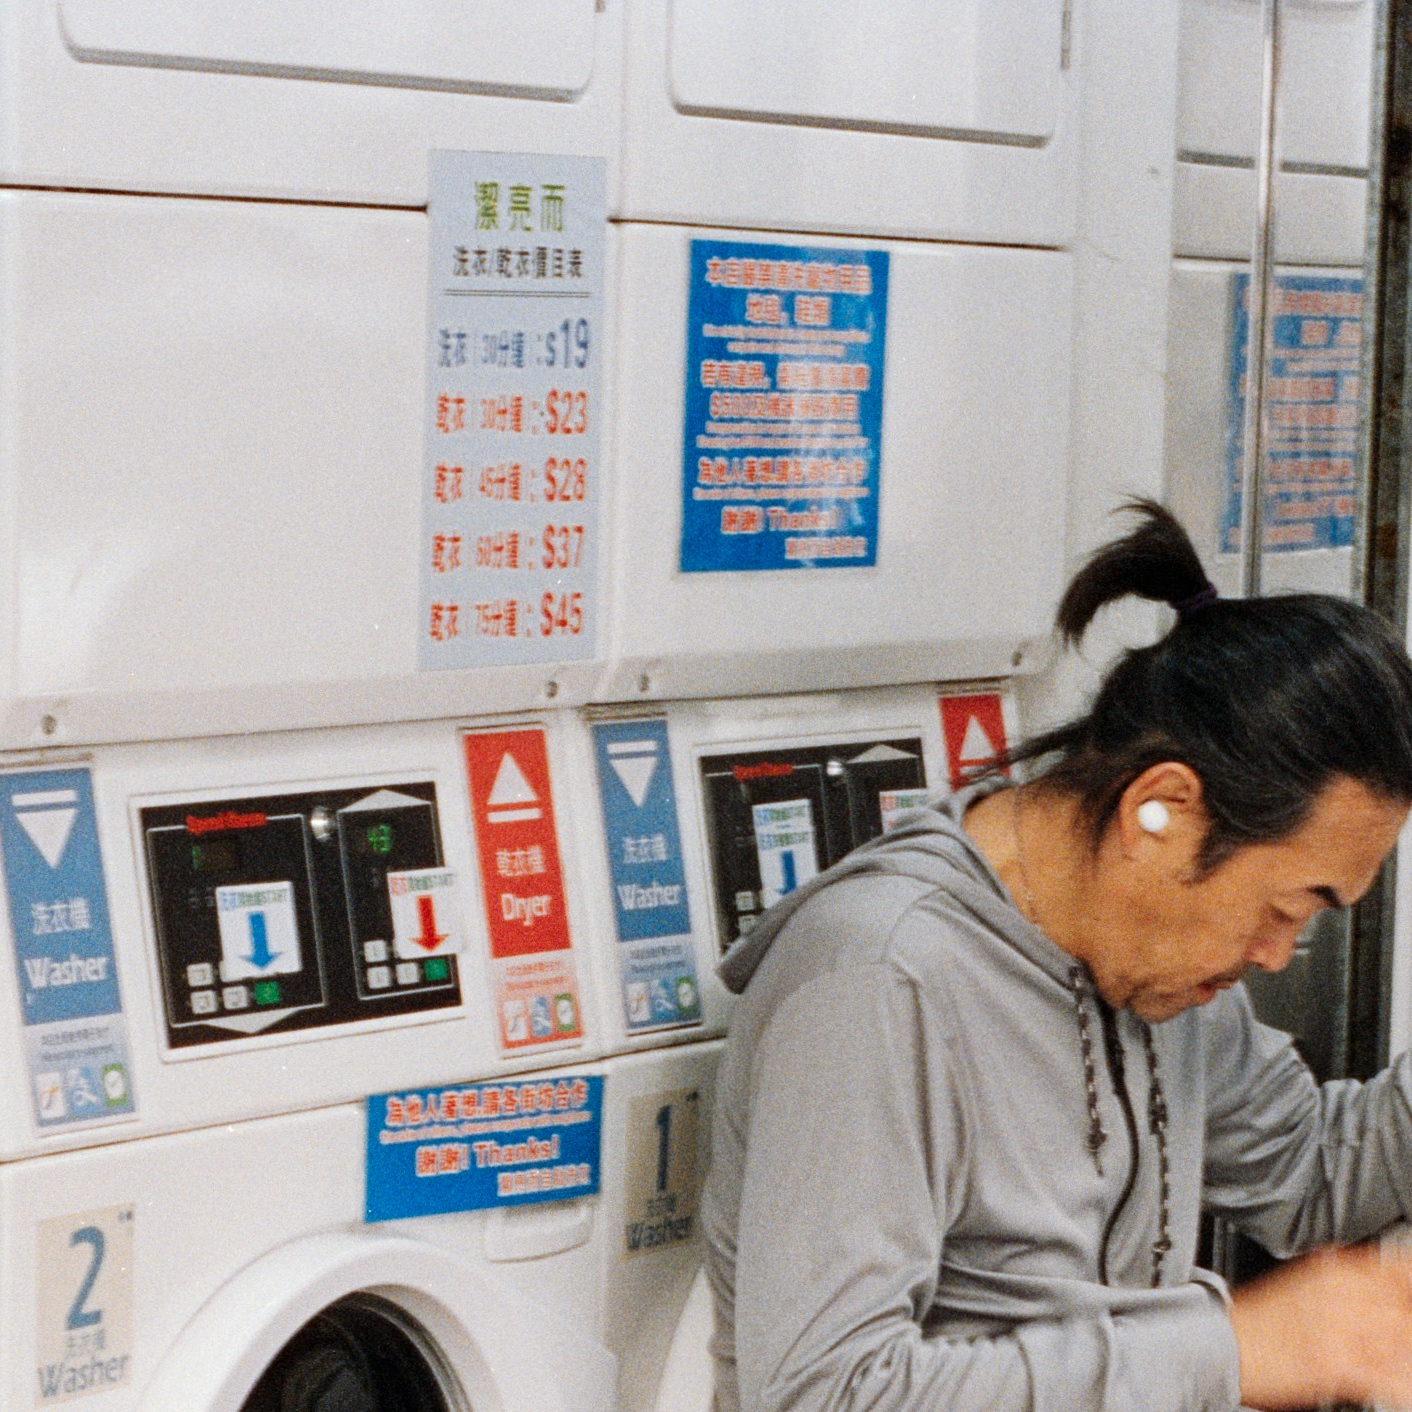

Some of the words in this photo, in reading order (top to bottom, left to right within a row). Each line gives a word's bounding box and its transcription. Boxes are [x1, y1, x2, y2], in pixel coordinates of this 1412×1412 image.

[501, 893, 551, 926] Dryer
[617, 881, 681, 910] Washer
[30, 897, 92, 936] 洗衣機
[24, 953, 109, 989] Washer
[472, 1134, 561, 1168] Thanks!
[655, 1104, 673, 1194] 1
[626, 1216, 692, 1252] Washer
[65, 1225, 106, 1331] 2
[36, 1353, 131, 1399] Washer
